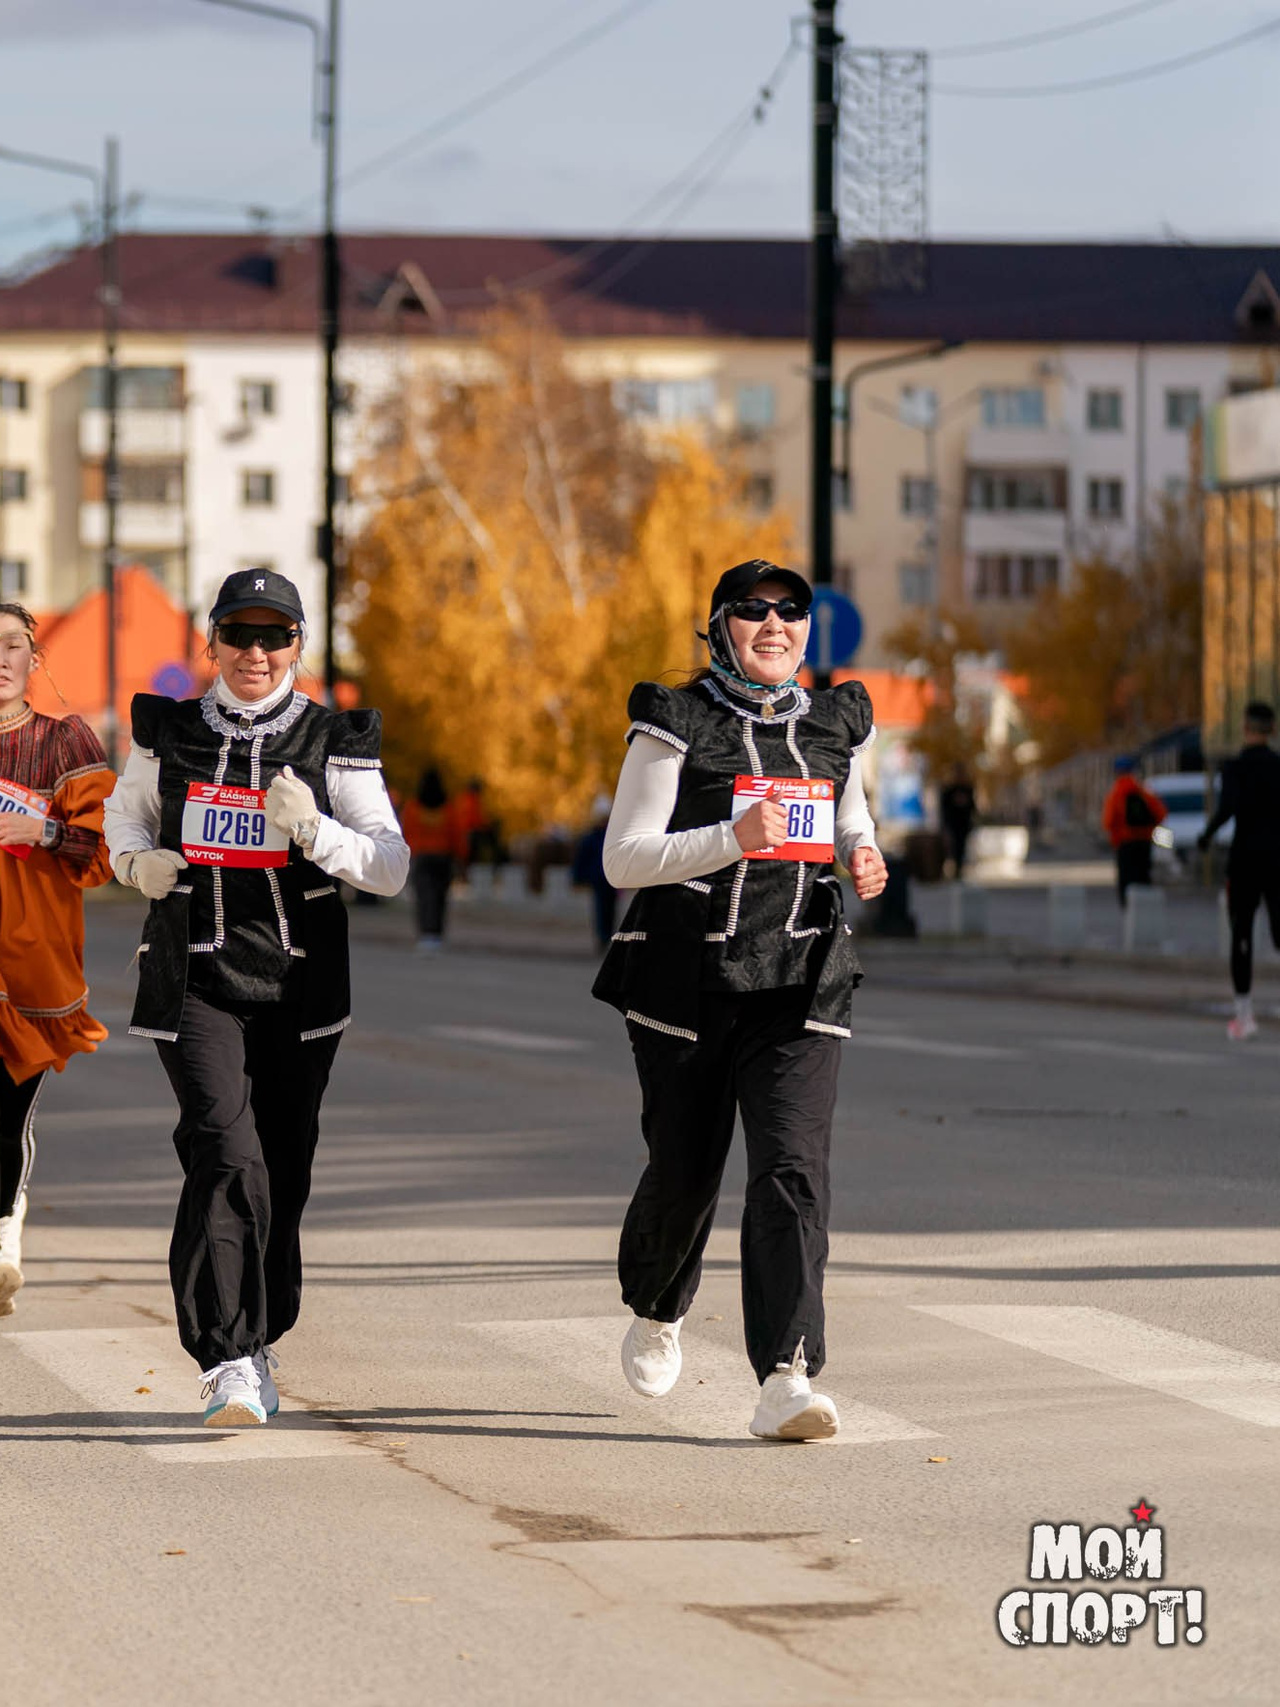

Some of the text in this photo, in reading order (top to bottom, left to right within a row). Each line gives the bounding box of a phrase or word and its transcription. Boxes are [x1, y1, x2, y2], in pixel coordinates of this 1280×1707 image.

[219, 792, 259, 802] ОЛОНХО
[202, 808, 266, 846] 0269
[184, 849, 224, 861] ЯКУТСК
